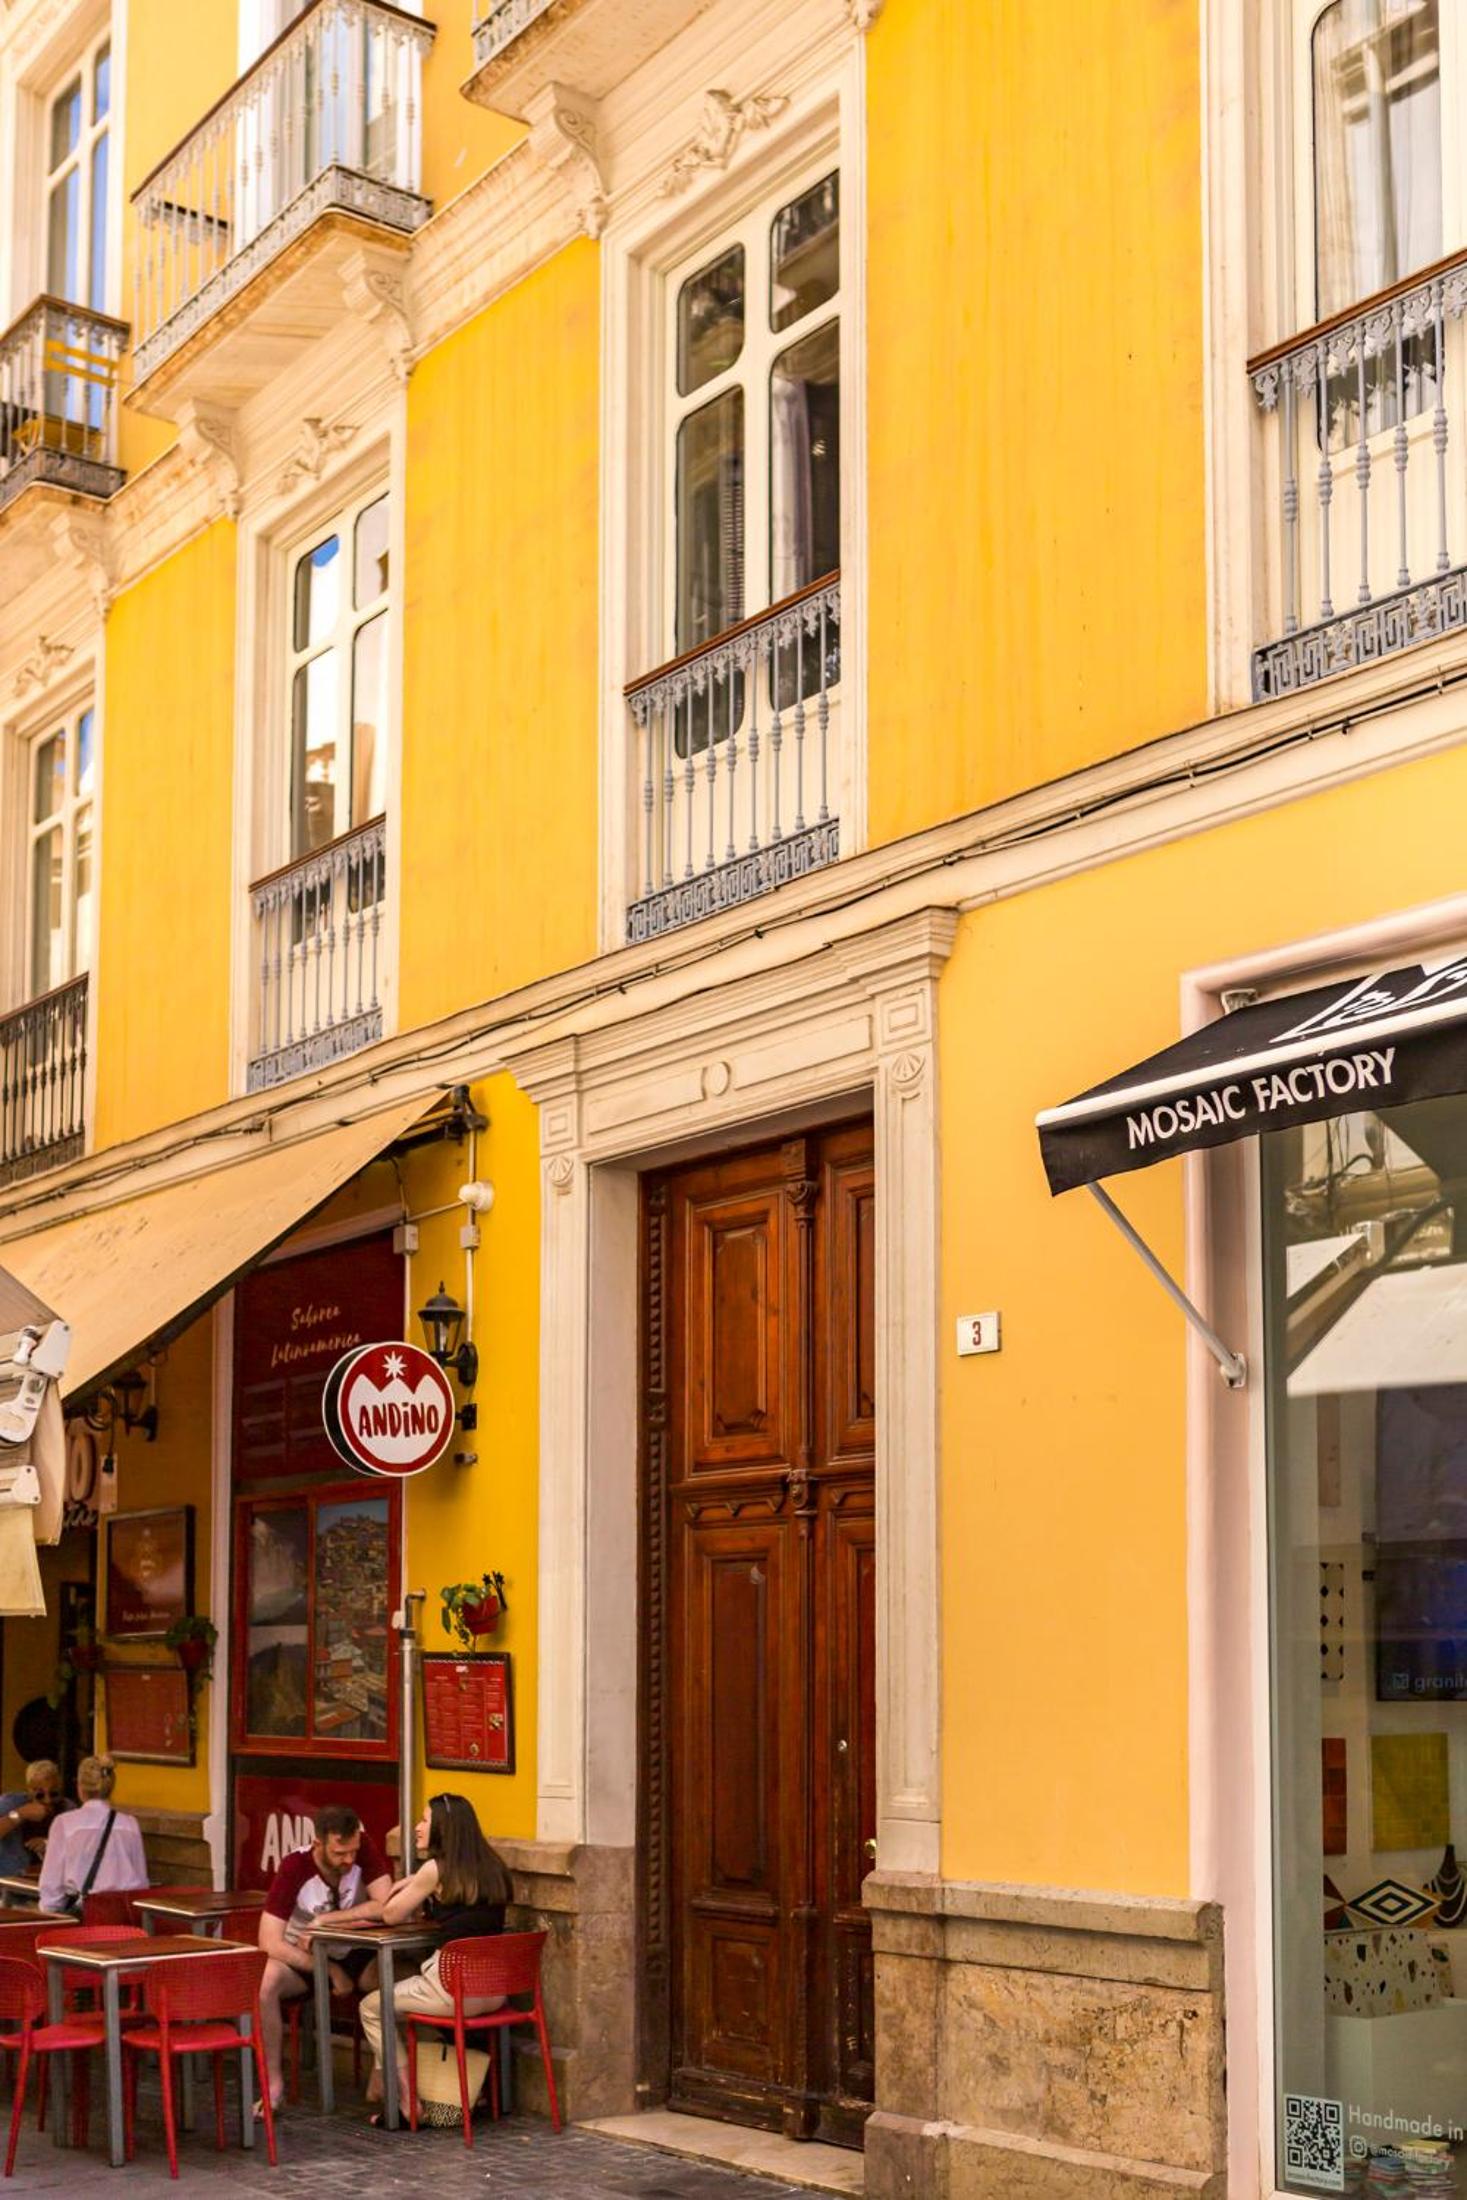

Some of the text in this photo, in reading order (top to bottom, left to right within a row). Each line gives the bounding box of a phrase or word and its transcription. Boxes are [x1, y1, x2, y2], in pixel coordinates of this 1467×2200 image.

[1126, 1047, 1396, 1149] MOSAIC FACTORY
[972, 1320, 982, 1346] 3
[1349, 2103, 1464, 2141] Handmade in
